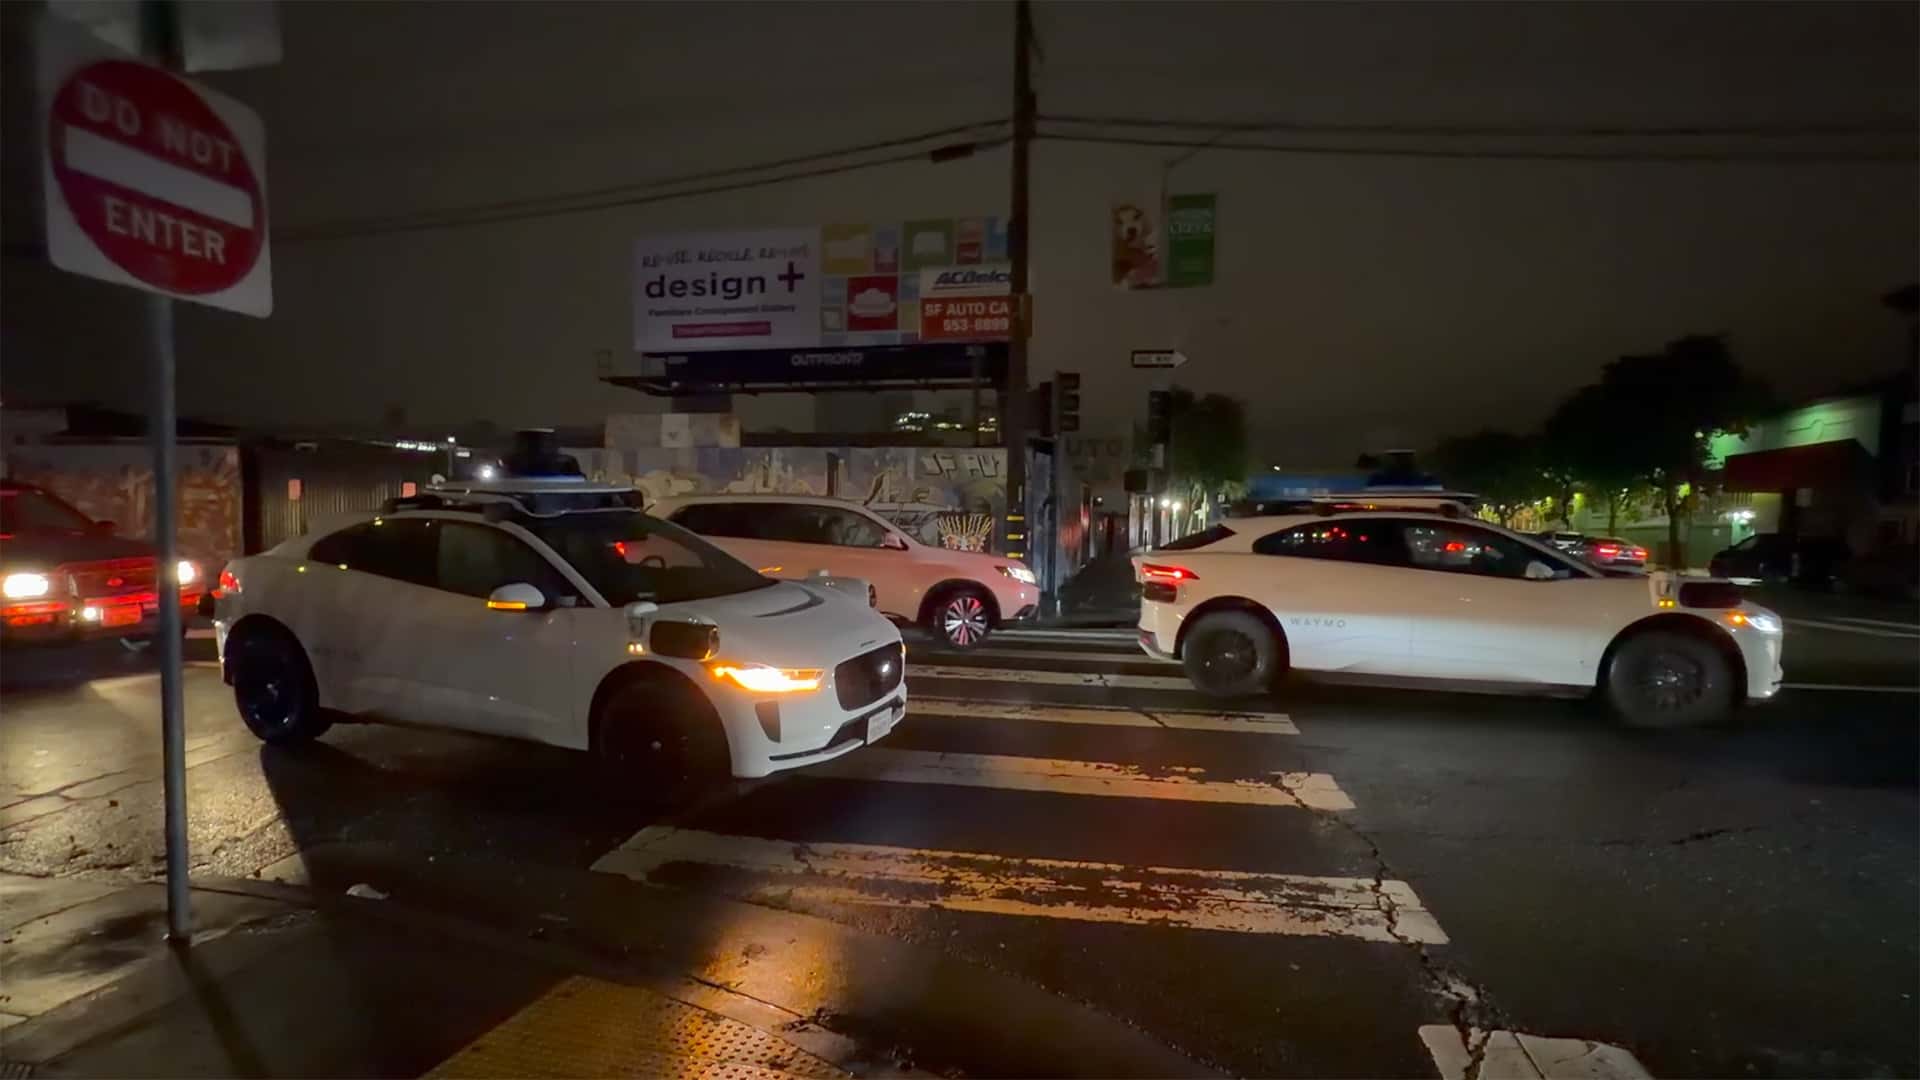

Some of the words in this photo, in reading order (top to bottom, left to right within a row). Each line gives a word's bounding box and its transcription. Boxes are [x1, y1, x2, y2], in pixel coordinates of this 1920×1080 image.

[79, 80, 143, 136] DO
[158, 113, 235, 173] NOT
[104, 195, 227, 265] ENTER
[645, 271, 766, 300] design
[925, 303, 945, 316] SF
[946, 302, 986, 316] AUTO
[1290, 617, 1346, 629] WAYMO
